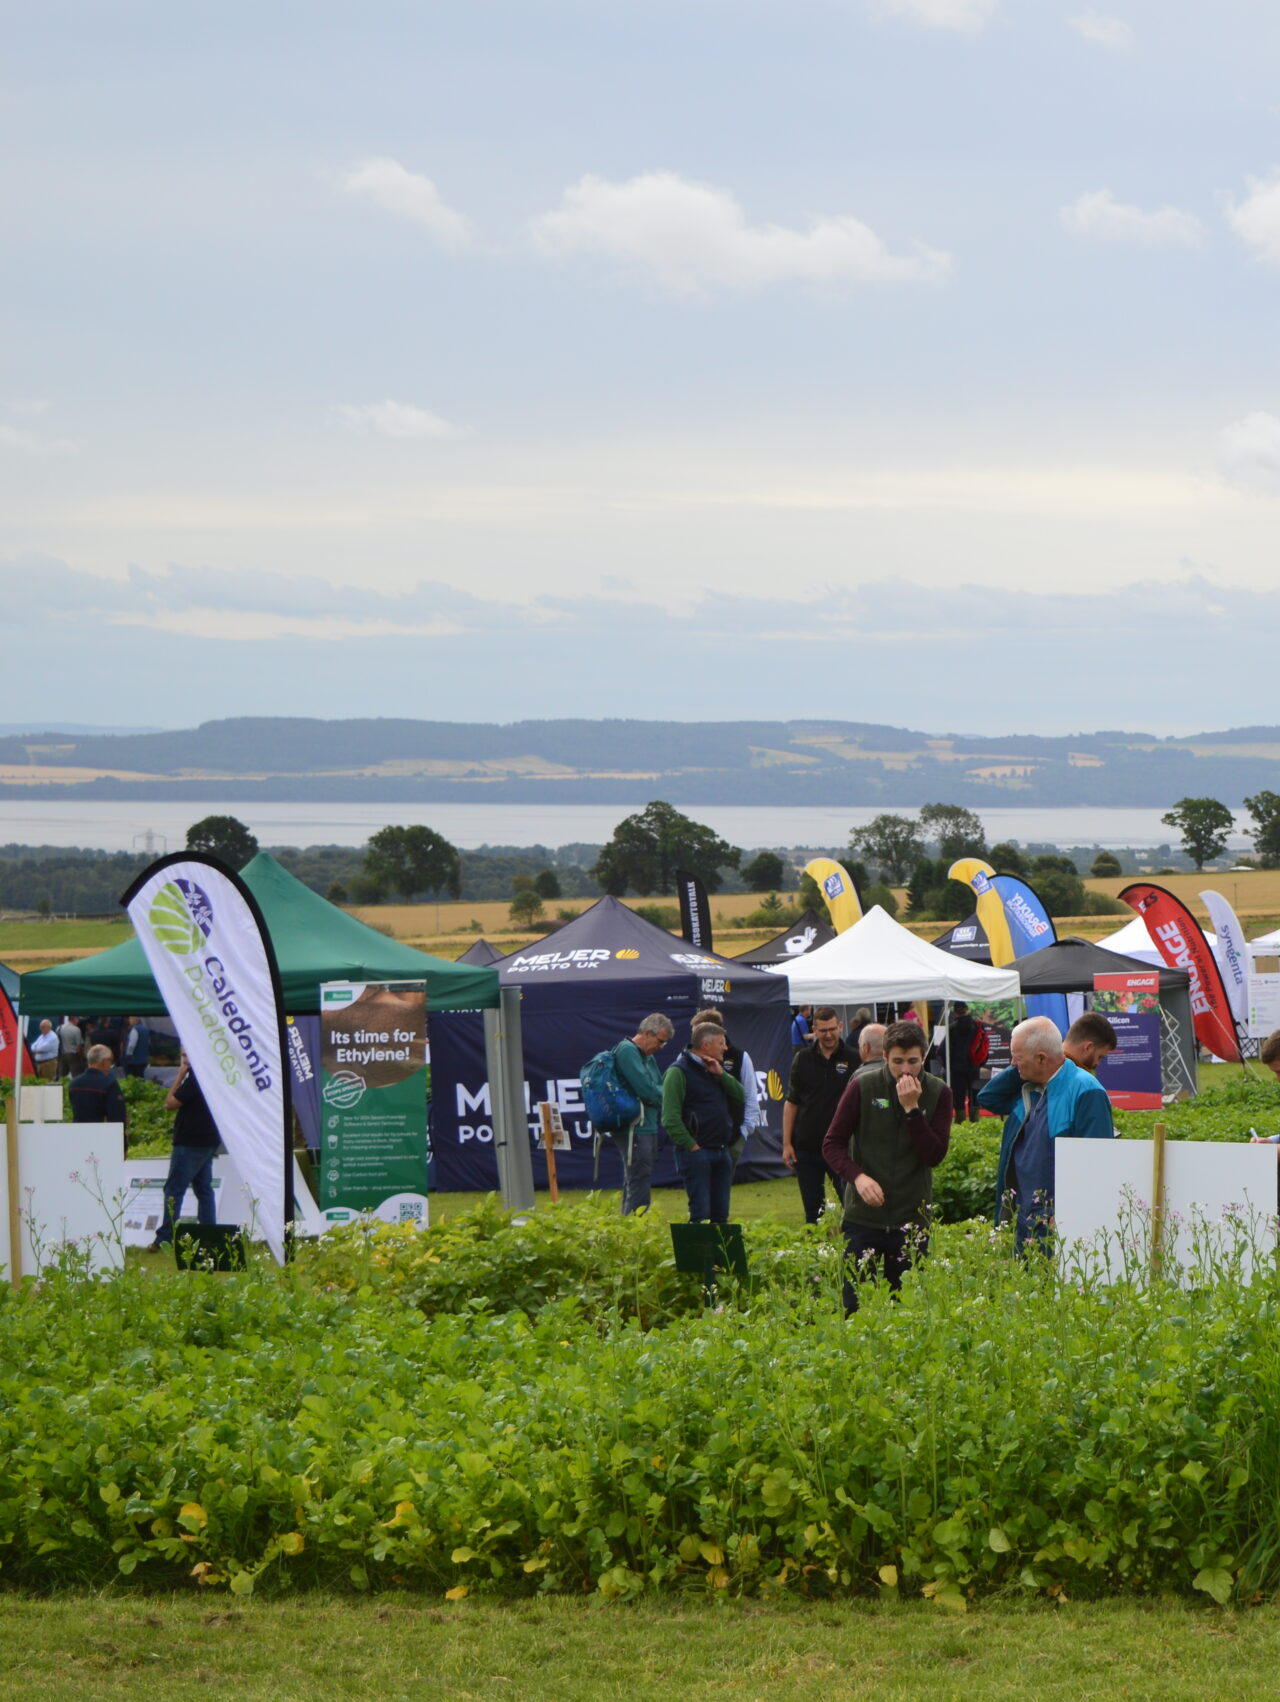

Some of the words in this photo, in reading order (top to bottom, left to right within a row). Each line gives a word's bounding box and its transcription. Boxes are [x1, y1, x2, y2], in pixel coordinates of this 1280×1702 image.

[1138, 892, 1158, 913] ECS
[512, 949, 611, 967] MEIJER
[1220, 924, 1243, 985] syngenta
[507, 962, 570, 973] POTATO
[576, 961, 600, 969] UK
[1155, 920, 1210, 1016] ENGAGE
[1126, 978, 1155, 987] ENGAGE
[183, 965, 242, 1087] potatoes
[204, 956, 272, 1092] Caledonia
[330, 1030, 350, 1044] Its
[354, 1029, 389, 1044] time
[393, 1028, 417, 1042] for
[336, 1046, 410, 1065] Ethylene!
[456, 1078, 586, 1117] MIJE
